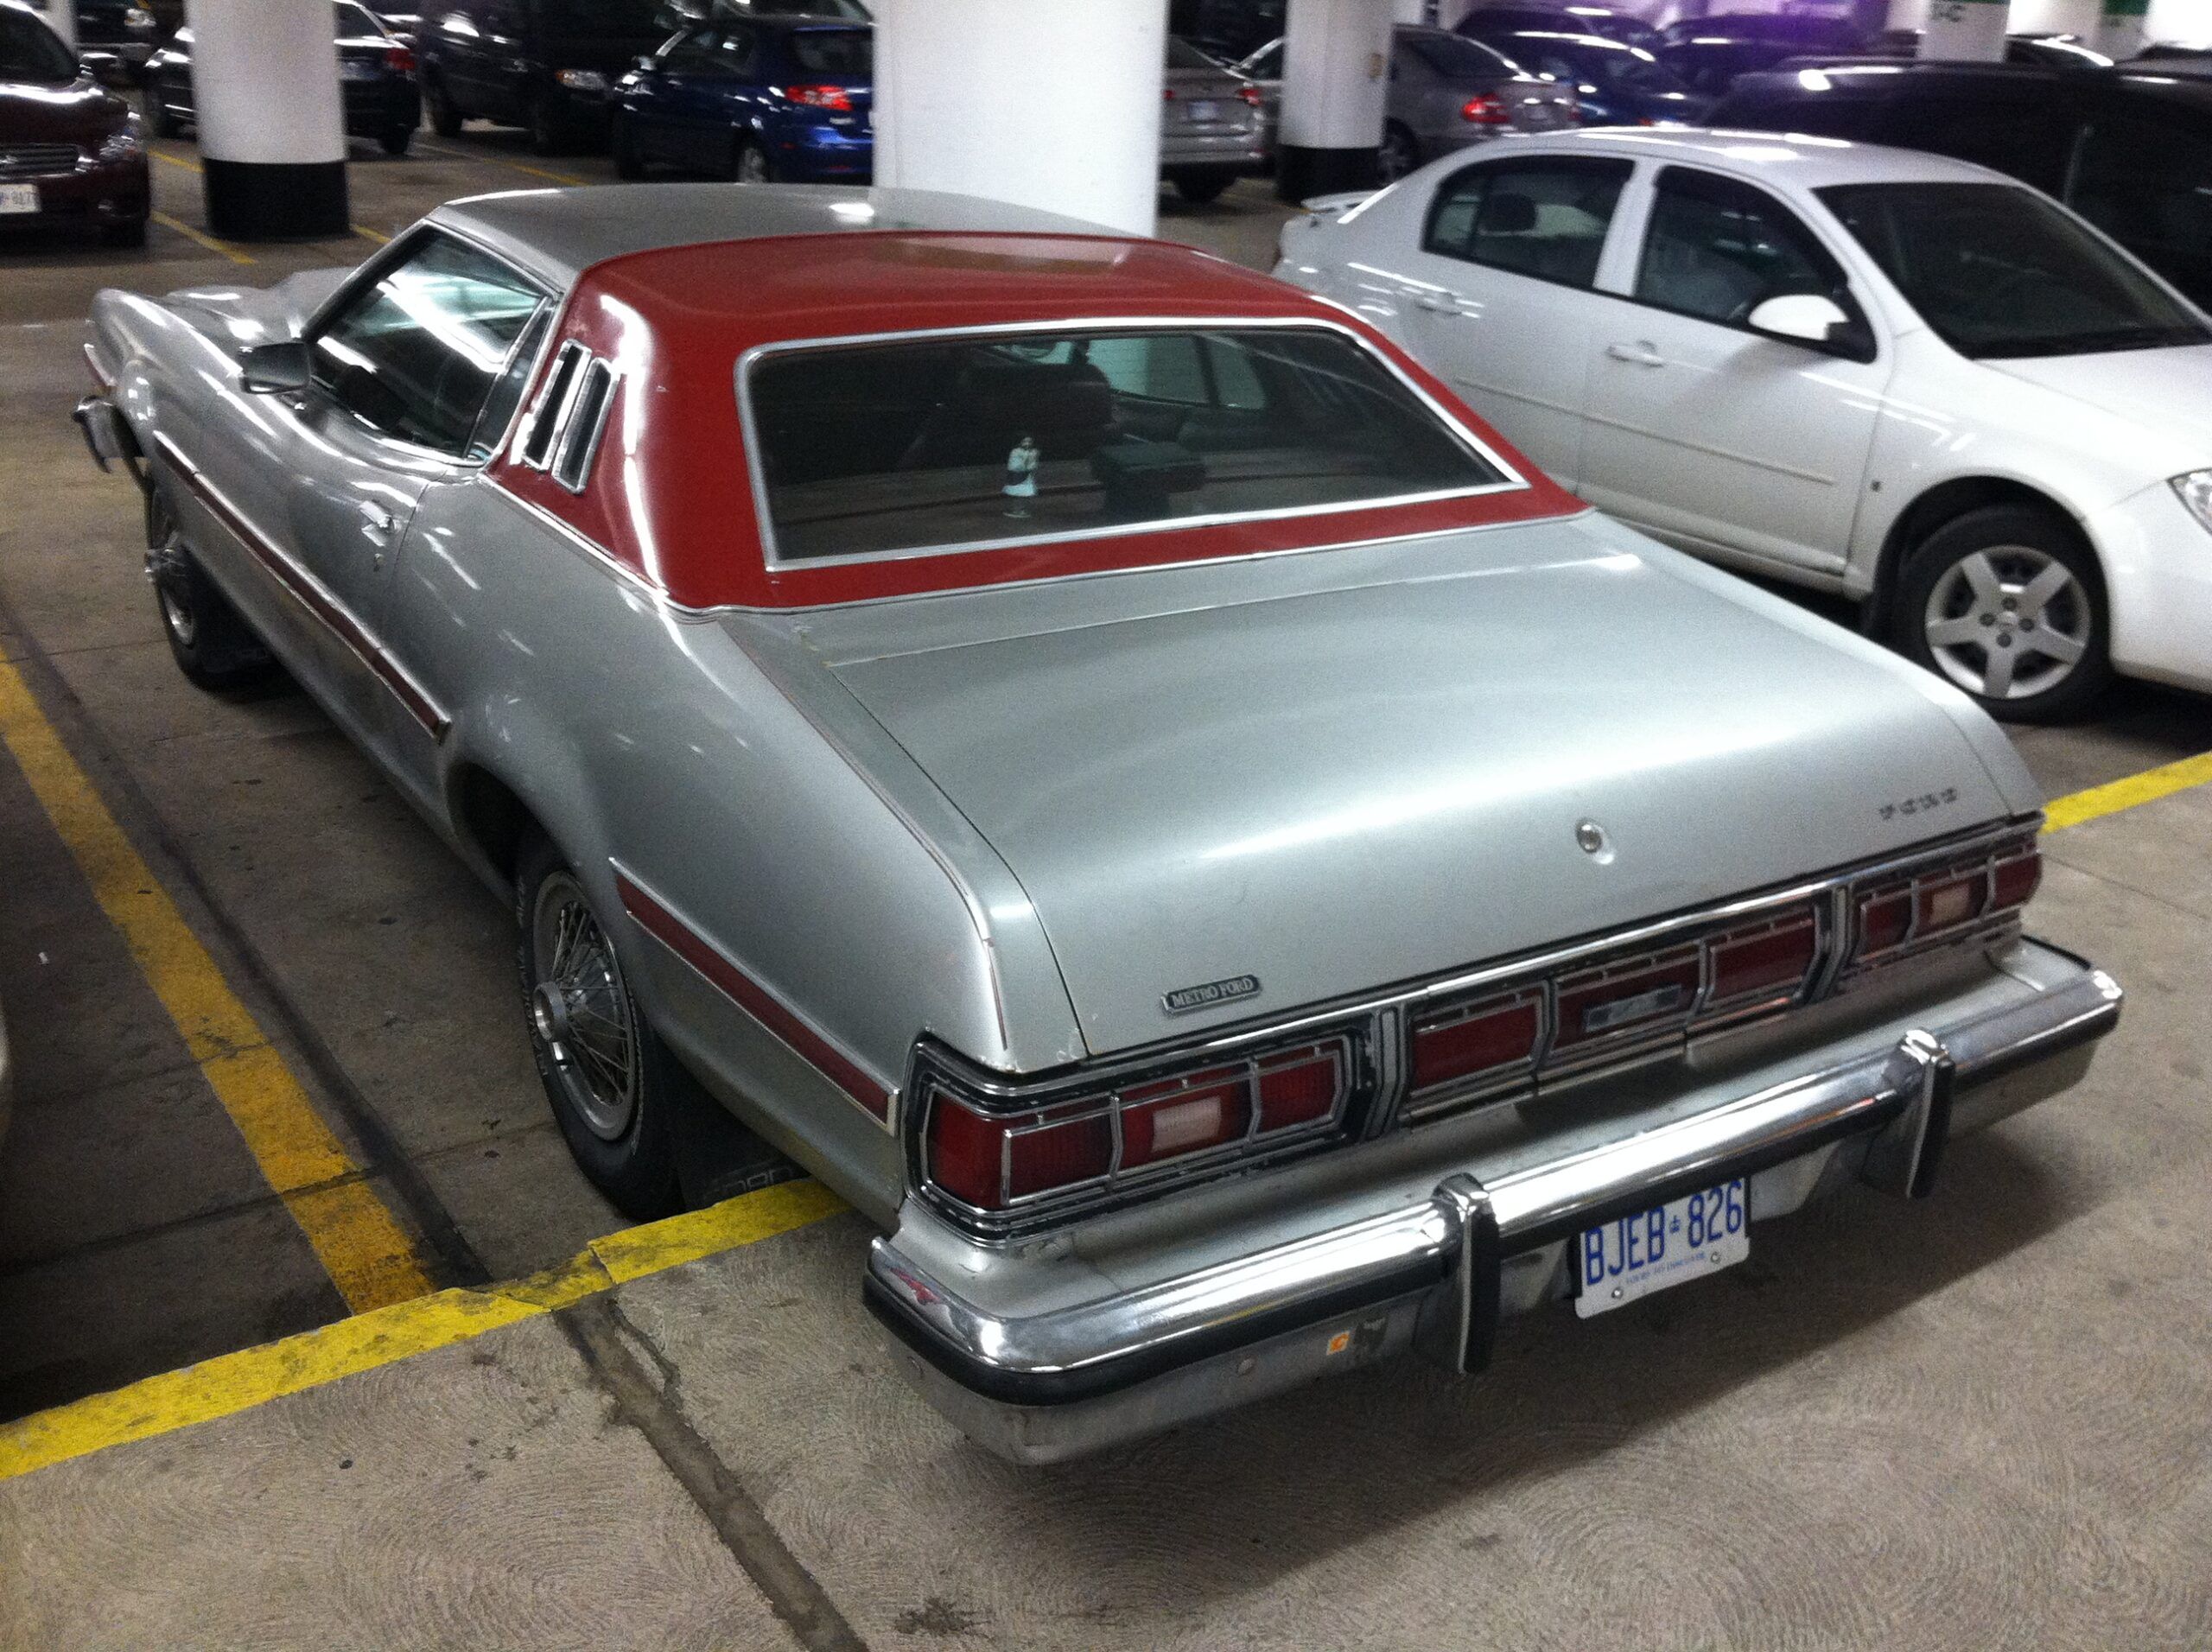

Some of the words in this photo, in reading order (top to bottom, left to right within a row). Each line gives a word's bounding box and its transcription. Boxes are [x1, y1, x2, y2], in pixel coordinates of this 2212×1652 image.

[1170, 985, 1219, 1007] METRO
[1219, 977, 1254, 996] FORD
[1585, 1205, 1665, 1286] BJEB
[1688, 1180, 1743, 1249] 826
